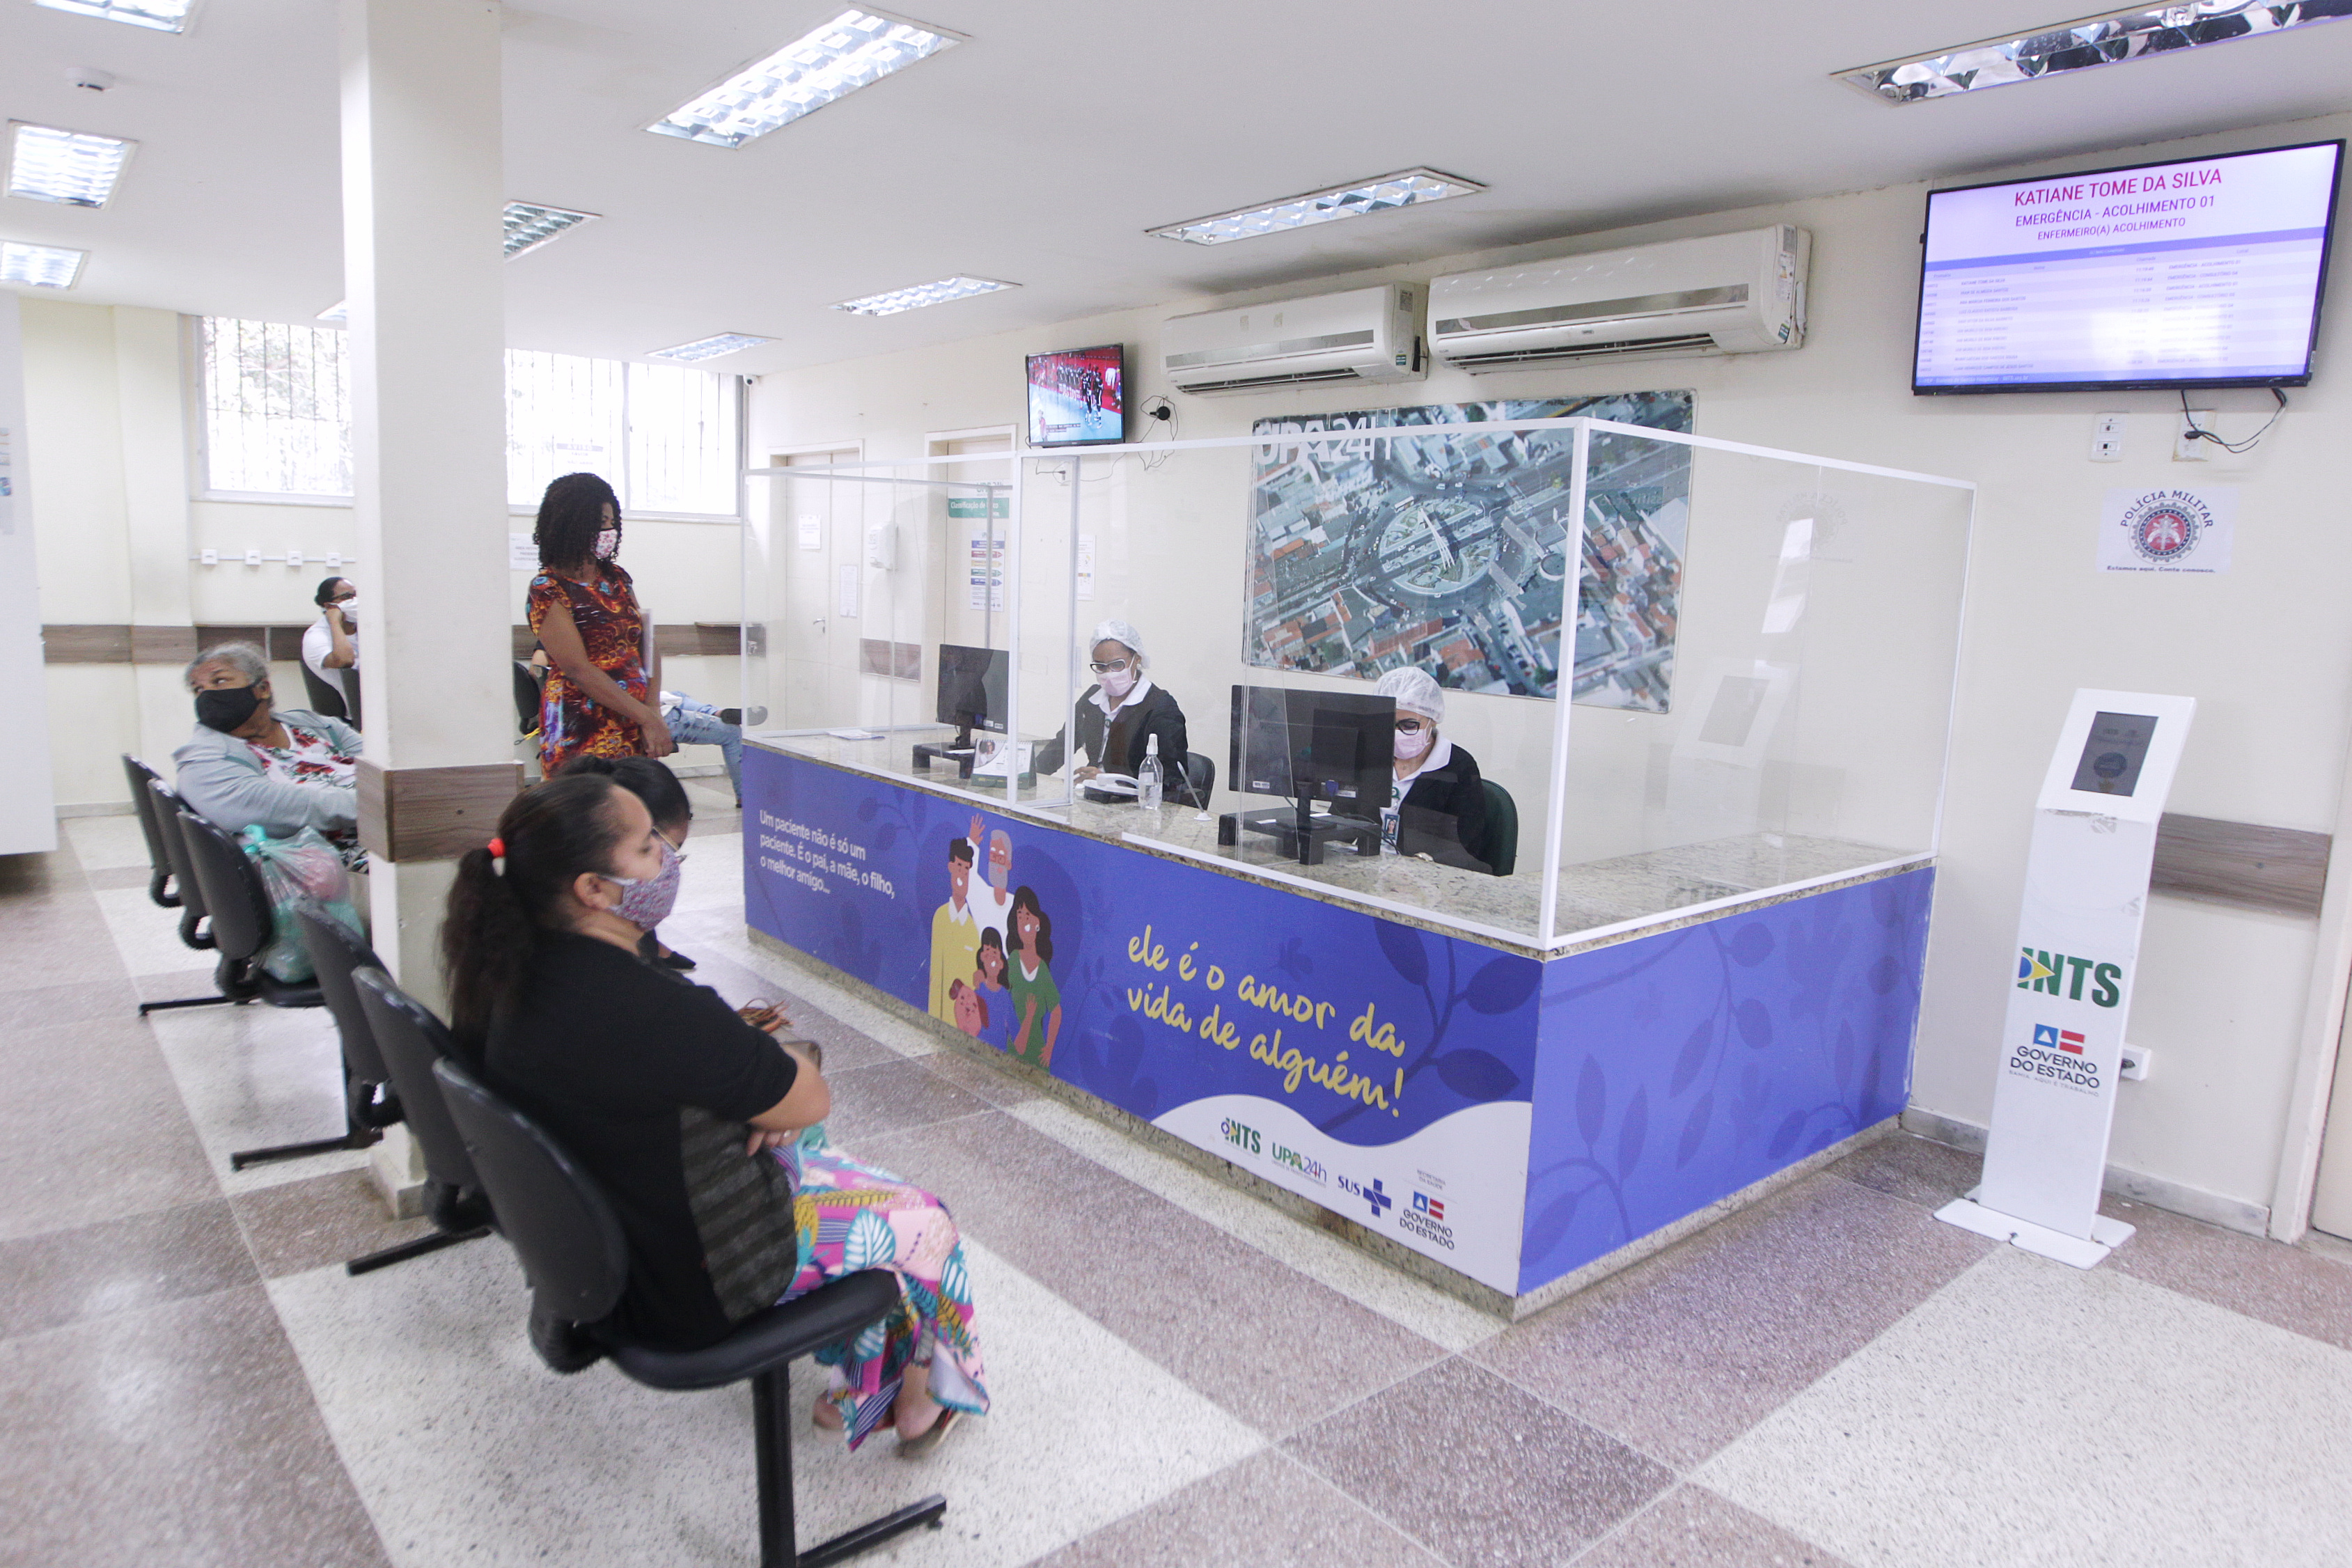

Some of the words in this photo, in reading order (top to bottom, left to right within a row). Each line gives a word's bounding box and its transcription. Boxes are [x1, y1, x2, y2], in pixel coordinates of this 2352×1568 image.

[2014, 184, 2085, 207] KATIANE
[2089, 178, 2138, 198] TOME
[2142, 175, 2166, 192] DA
[2172, 168, 2222, 189] SILVA
[2016, 209, 2092, 227] EMERGÊNCIA
[2102, 197, 2195, 219] ACOLHIMENTO
[2200, 196, 2215, 208] 01
[2038, 224, 2110, 241] ENFERMEIRO(A)
[2113, 217, 2186, 233] ACOLHIMENTO
[950, 501, 979, 510] Classificação
[2120, 490, 2167, 527] POLÍCIA
[2171, 489, 2213, 528] MILITAR
[760, 809, 774, 828] Um
[775, 819, 810, 840] paciente
[811, 829, 829, 847] não
[829, 833, 836, 849] é
[837, 838, 849, 854] só
[849, 844, 866, 861] um
[760, 834, 797, 859] paciente.
[797, 841, 803, 861] É
[805, 851, 812, 863] o
[813, 854, 829, 873] pai,
[829, 860, 836, 873] a
[837, 862, 861, 886] mãe,
[861, 872, 869, 886] o
[870, 870, 895, 900] filho,
[760, 855, 767, 868] o
[767, 857, 796, 879] melhor
[796, 870, 831, 895] amigo...
[1128, 924, 1170, 972] ele
[1179, 941, 1200, 982] é
[1206, 964, 1225, 991] o
[1238, 974, 1336, 1030] amor
[1349, 1001, 1406, 1058] da
[2017, 946, 2122, 1008] INTS
[1127, 982, 1193, 1033] vida
[1199, 1003, 1241, 1051] de
[1249, 1028, 1404, 1118] alguém!
[2016, 1046, 2097, 1074] GOVERNO
[2010, 1057, 2035, 1072] DO
[2037, 1063, 2101, 1088] ESTADO
[1223, 1117, 1262, 1154] INTS
[1338, 1175, 1361, 1196] SUS
[1400, 1217, 1415, 1232] DO
[1416, 1225, 1455, 1251] ESTADO
[1403, 1209, 1453, 1239] GOVERNO
